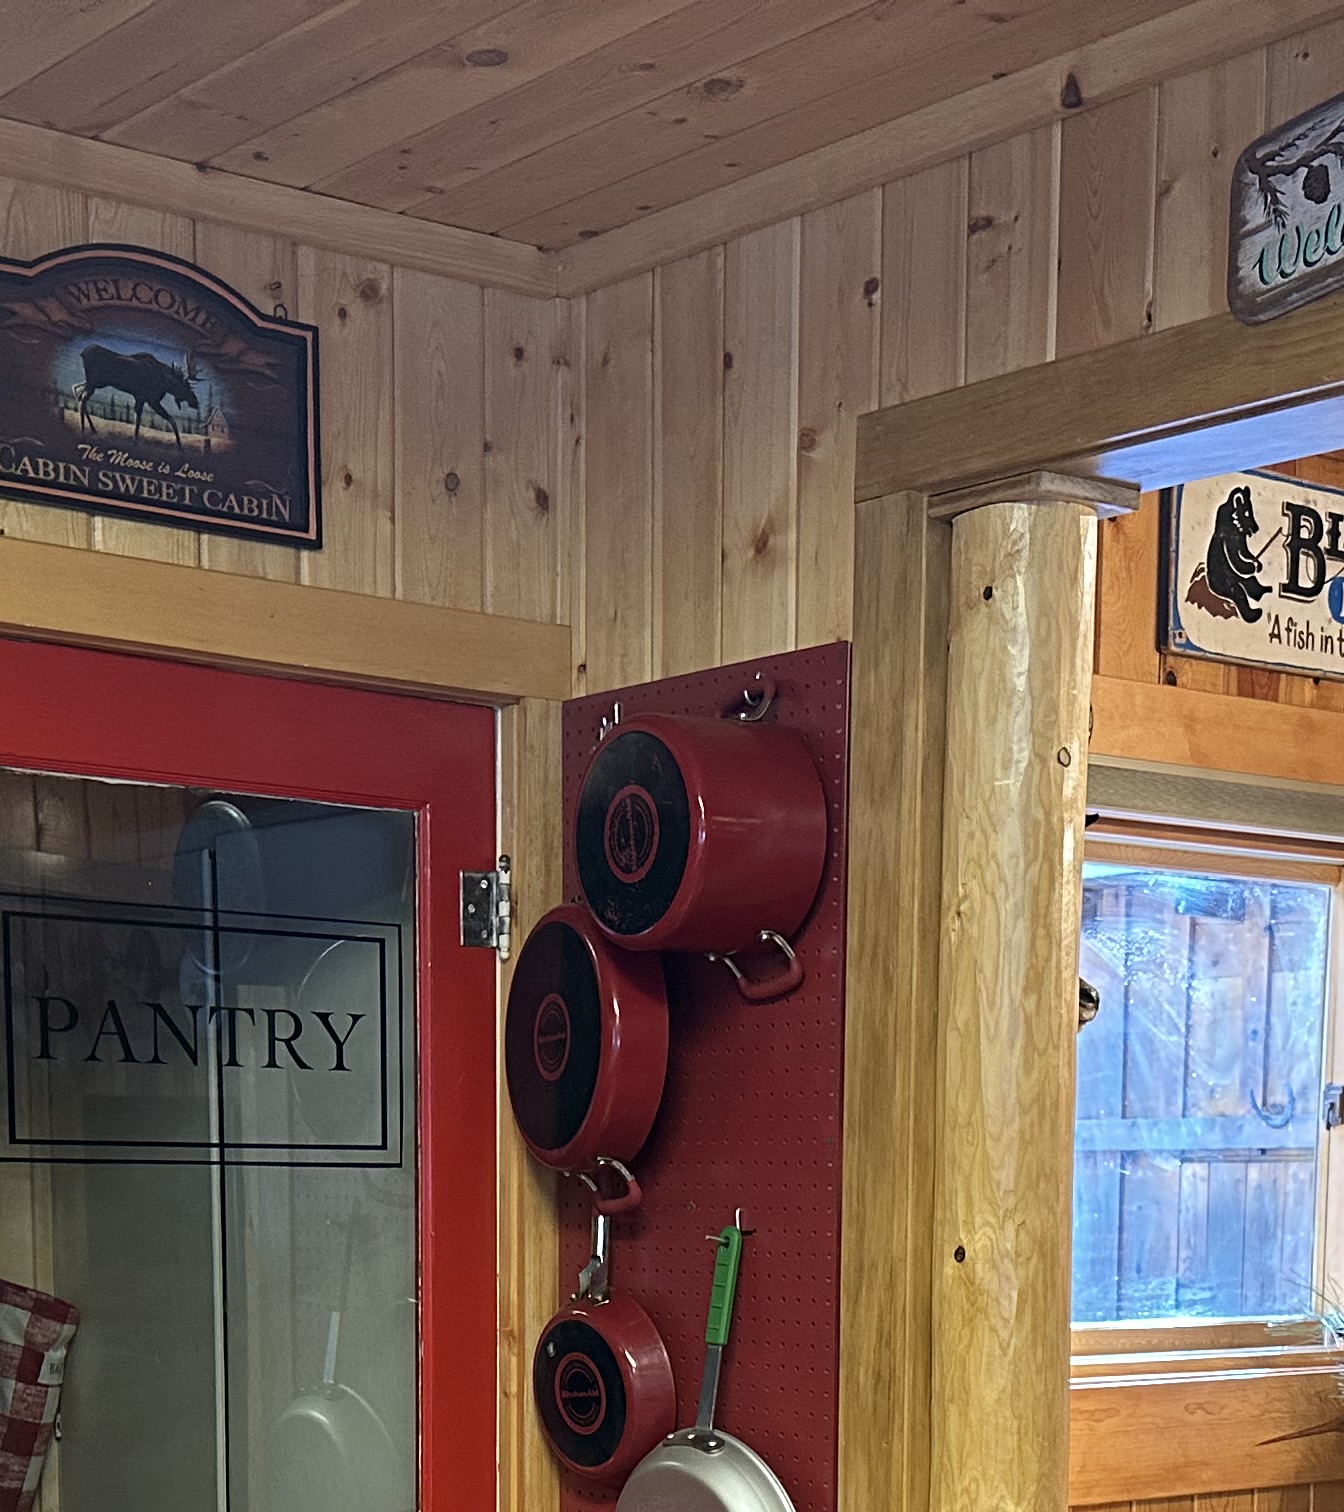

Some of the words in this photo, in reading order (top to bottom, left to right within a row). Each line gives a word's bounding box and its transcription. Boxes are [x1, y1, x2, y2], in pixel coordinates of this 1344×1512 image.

[65, 279, 219, 333] WELCOME
[77, 444, 104, 462] The
[108, 449, 153, 472] Moose
[158, 461, 170, 474] is
[175, 463, 215, 482] Loose
[98, 470, 197, 505] SWEET
[203, 489, 291, 523] CABIN
[1285, 617, 1314, 651] fish
[1320, 626, 1334, 655] in
[32, 996, 367, 1072] PANTRY
